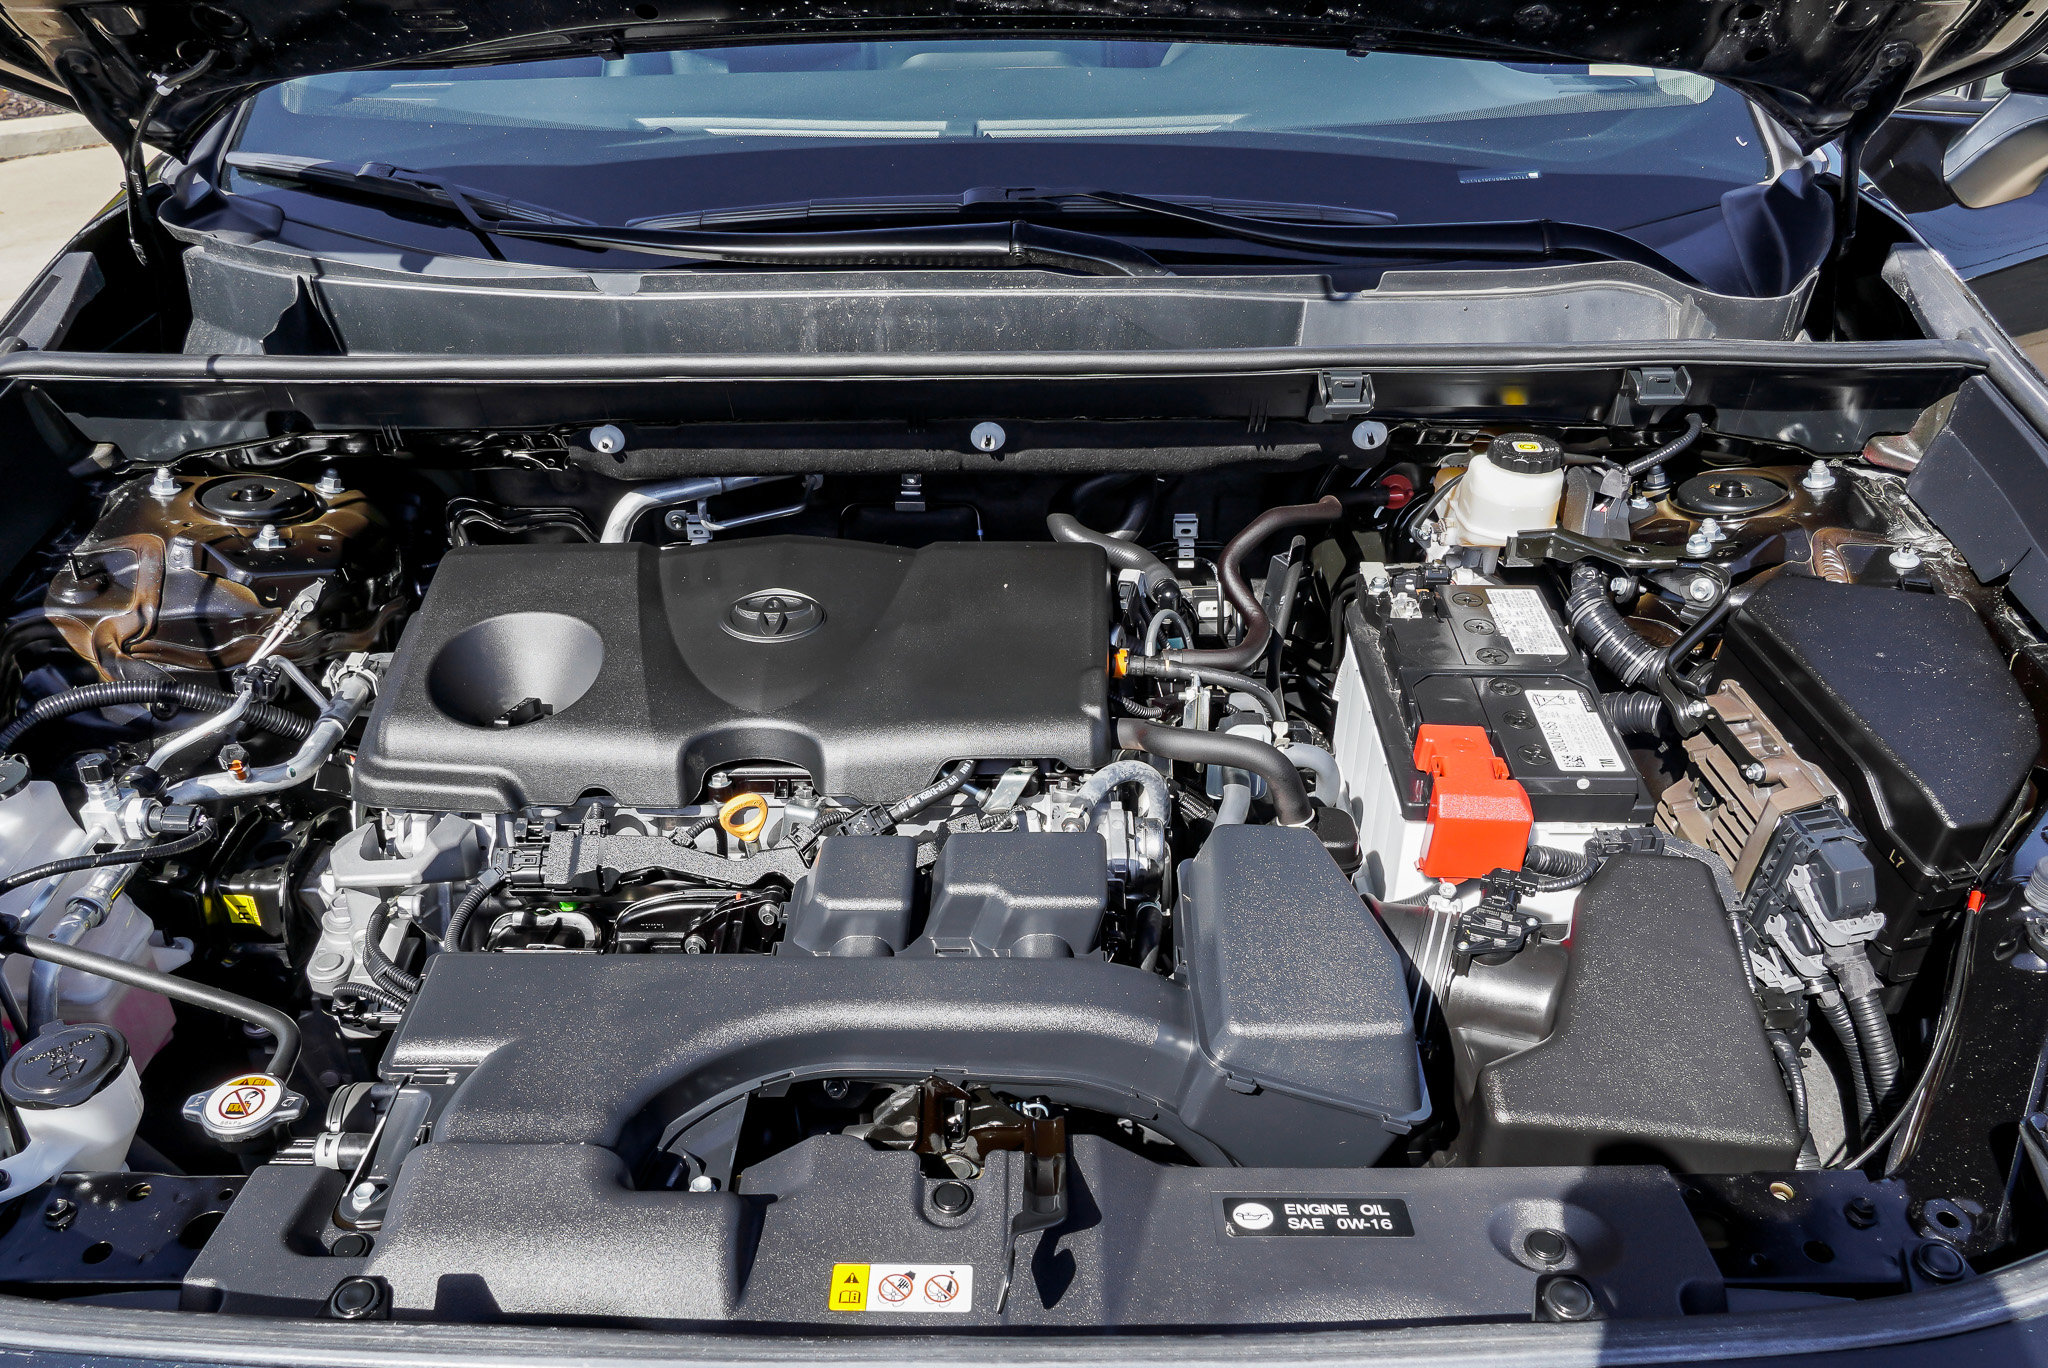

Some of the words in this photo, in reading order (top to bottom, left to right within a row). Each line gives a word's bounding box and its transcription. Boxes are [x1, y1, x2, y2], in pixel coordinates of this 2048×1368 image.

[1889, 849, 1905, 868] L7
[236, 904, 252, 921] R1
[1284, 1203, 1349, 1216] ENGINE
[1359, 1204, 1390, 1216] OIL
[1287, 1217, 1325, 1230] SAE
[1336, 1218, 1393, 1231] 0W-16
